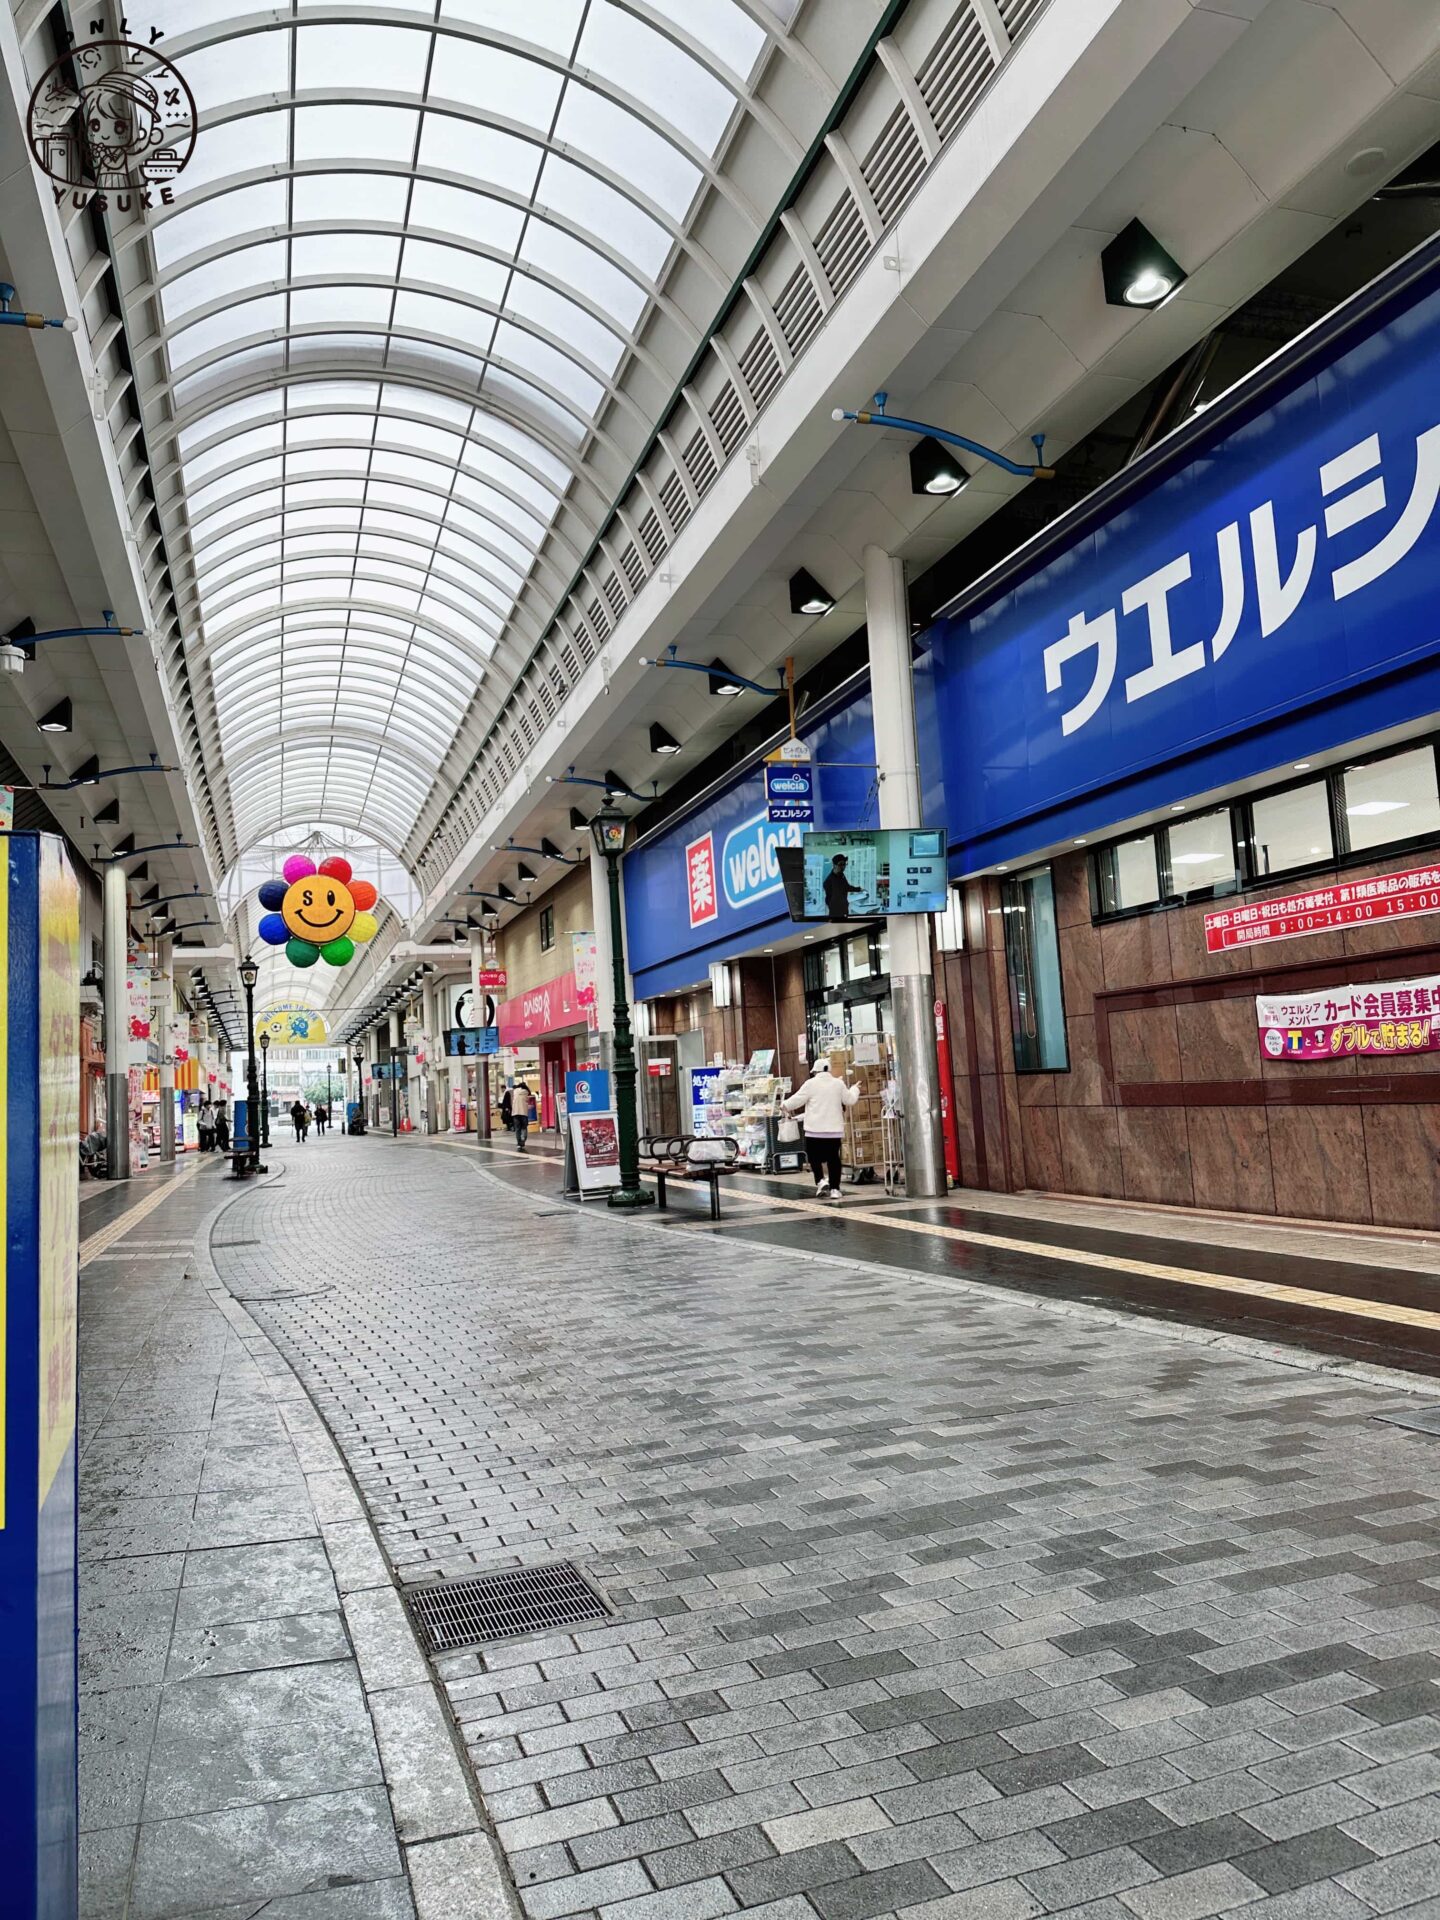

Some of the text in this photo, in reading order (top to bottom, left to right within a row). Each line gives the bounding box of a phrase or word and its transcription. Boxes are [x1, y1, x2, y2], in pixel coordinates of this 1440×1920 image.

[773, 777, 805, 791] welcia
[771, 809, 811, 818] ウエルシア
[691, 849, 713, 912] 薬
[302, 889, 313, 906] S
[523, 995, 543, 1018] DAISO
[1281, 1002, 1321, 1015] ウエルシア
[1288, 1014, 1319, 1026] メンバー
[1305, 1037, 1312, 1047] と
